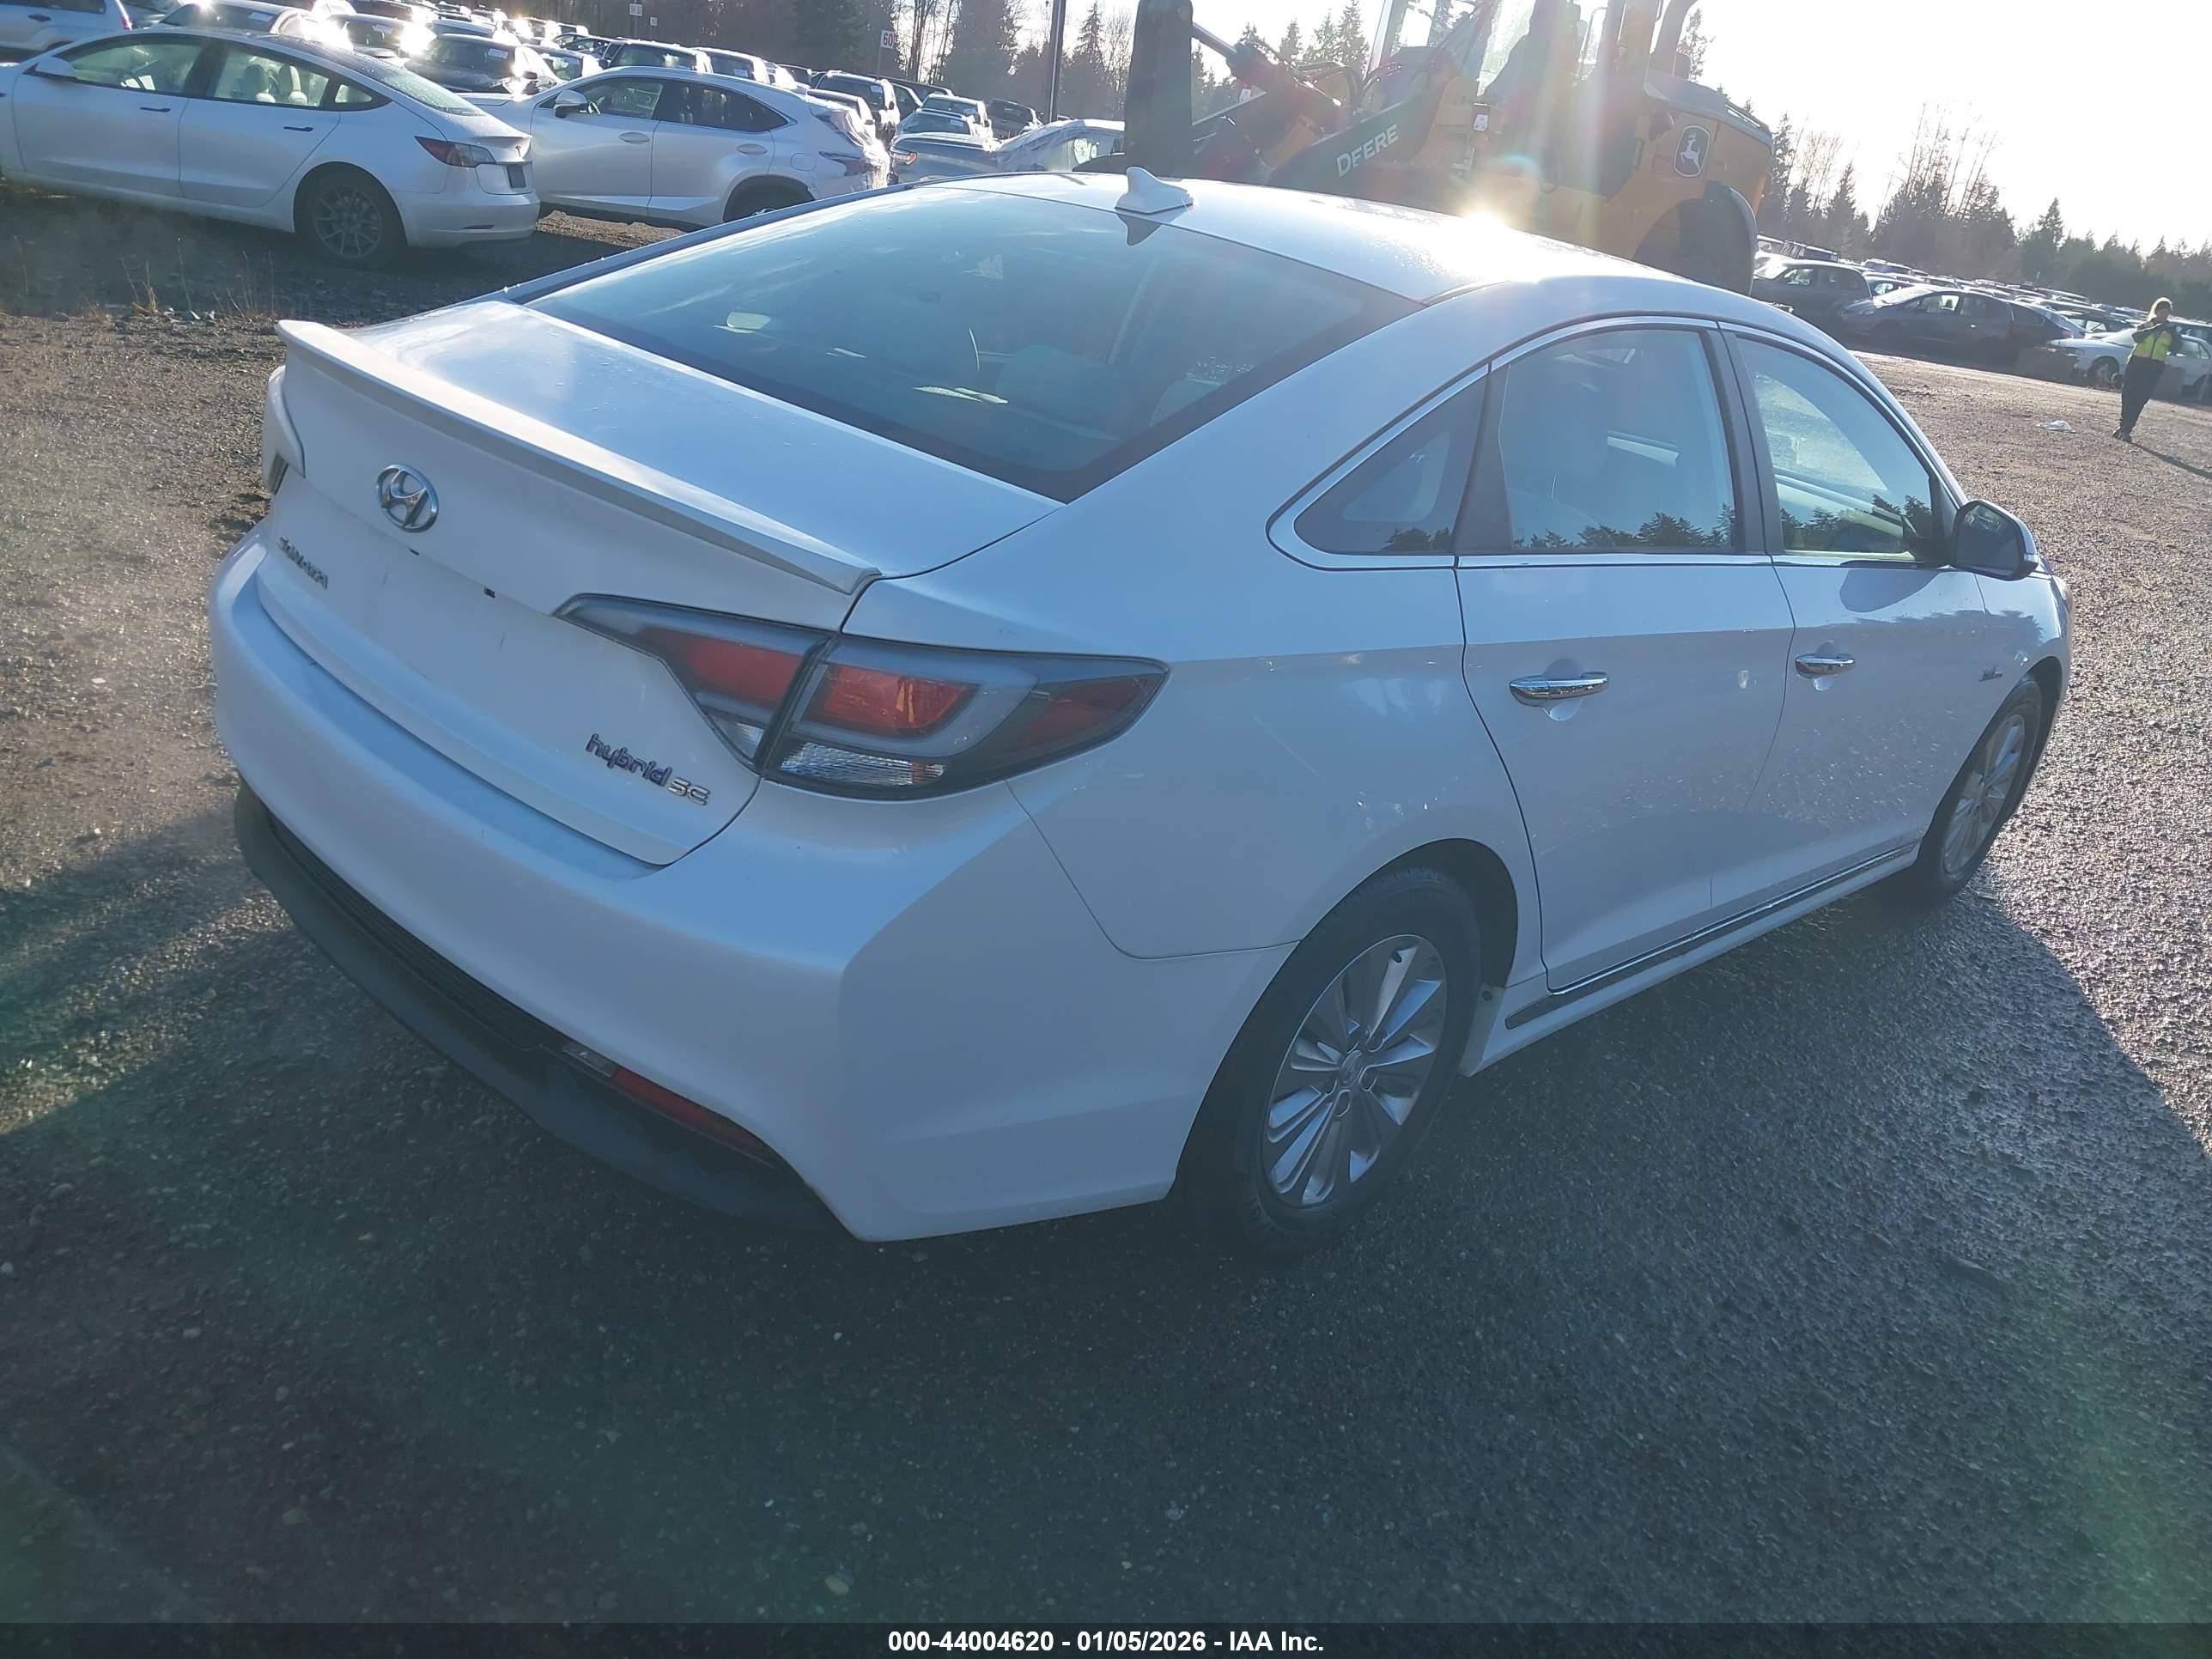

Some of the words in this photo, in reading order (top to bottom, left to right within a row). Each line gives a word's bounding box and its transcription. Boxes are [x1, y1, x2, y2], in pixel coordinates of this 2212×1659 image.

[883, 32, 893, 46] 60
[1336, 123, 1399, 178] DEERE
[586, 733, 673, 787] hybrid
